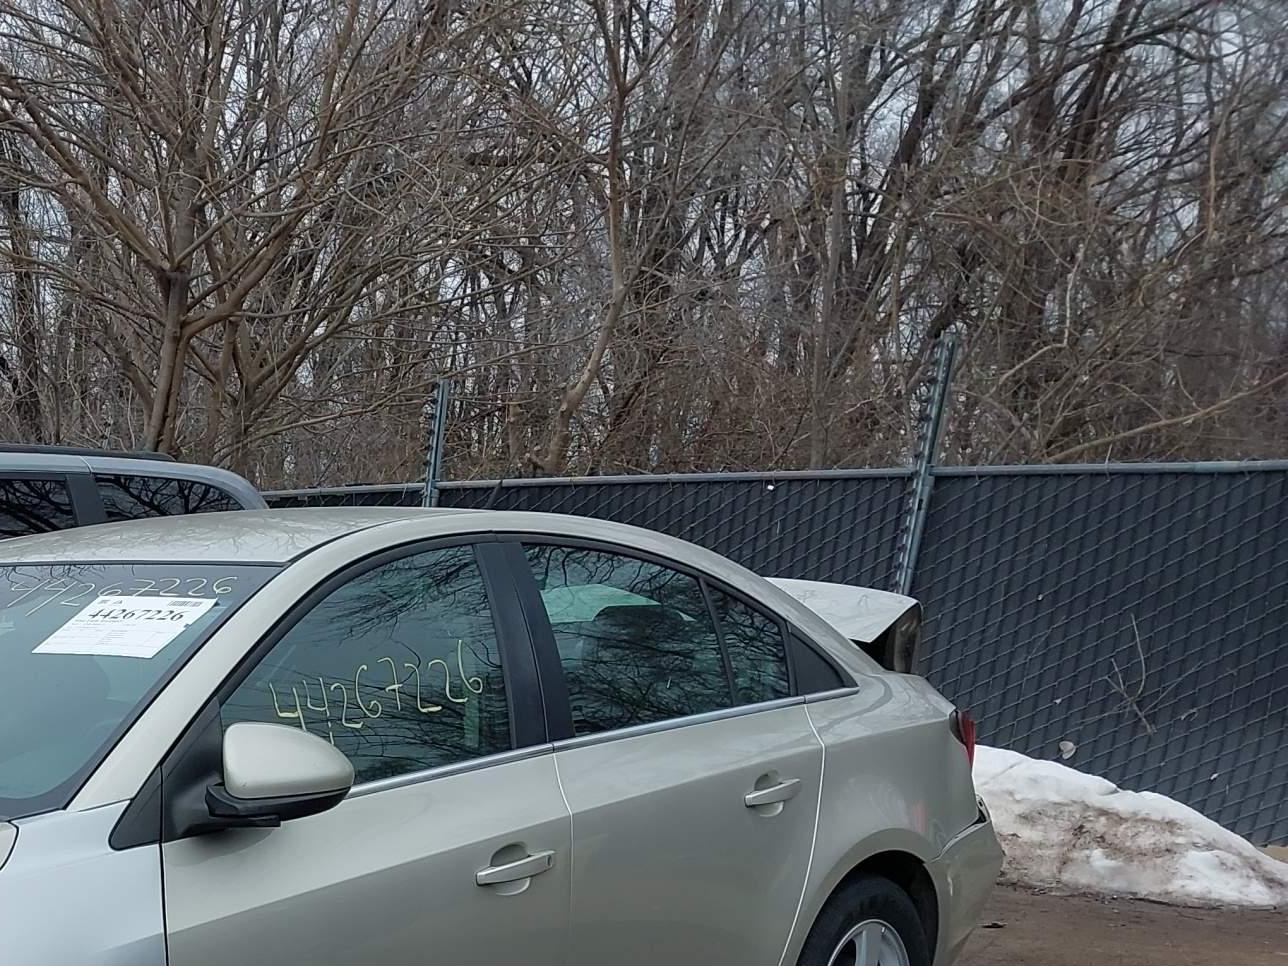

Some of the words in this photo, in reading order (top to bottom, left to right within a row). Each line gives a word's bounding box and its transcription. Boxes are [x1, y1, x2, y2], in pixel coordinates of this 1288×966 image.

[7, 576, 238, 617] 44267226
[87, 607, 191, 623] 44267226
[268, 638, 484, 746] 44267226
